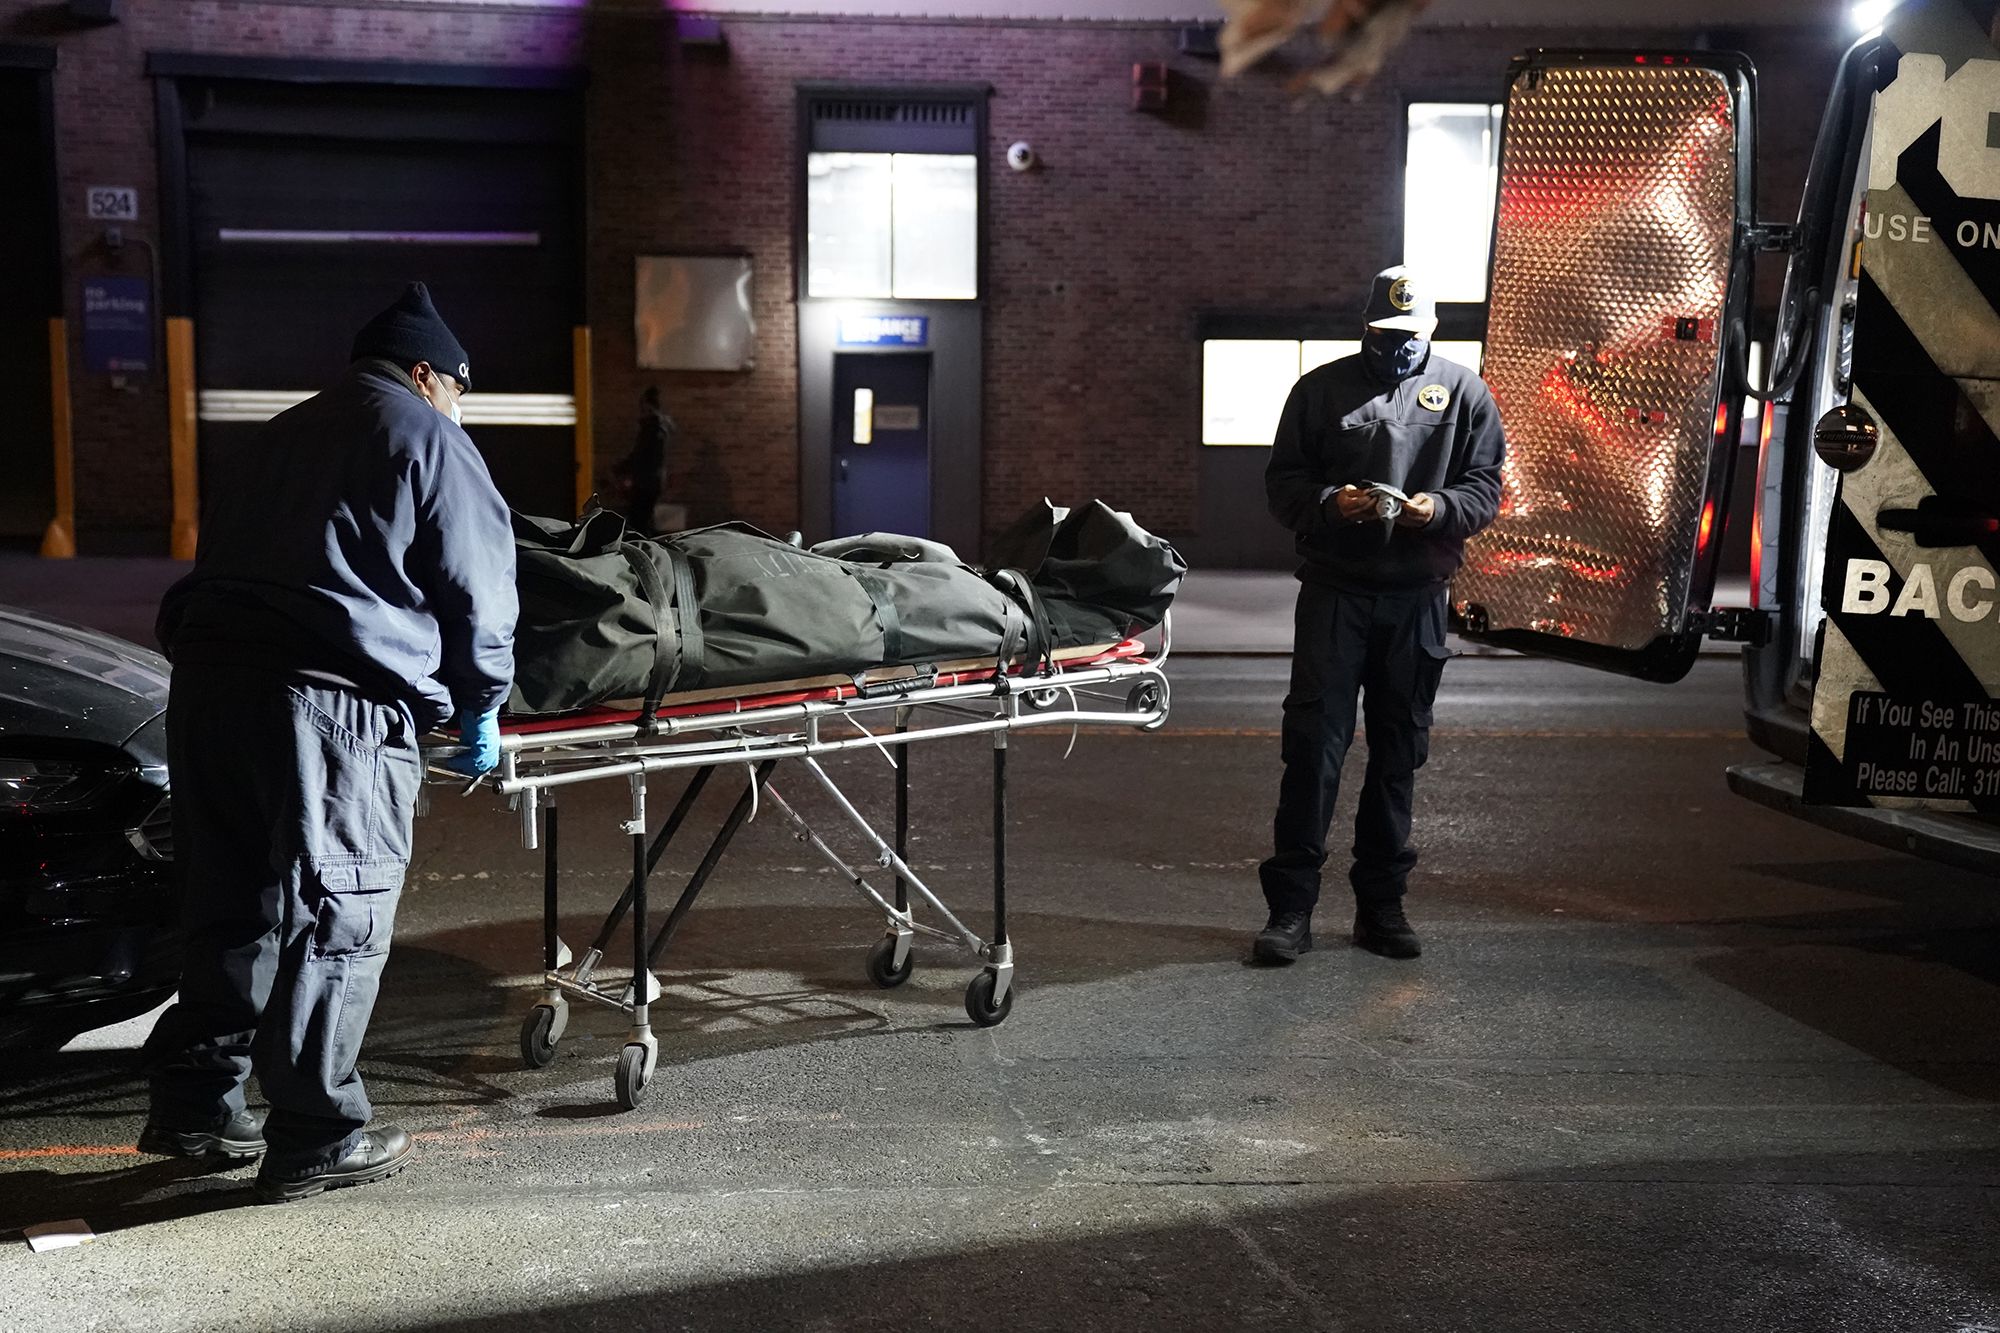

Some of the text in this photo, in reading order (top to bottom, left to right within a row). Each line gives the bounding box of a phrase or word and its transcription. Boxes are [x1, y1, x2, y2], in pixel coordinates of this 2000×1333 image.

[92, 192, 130, 215] 524
[1863, 211, 1932, 243] USE
[1841, 558, 2000, 624] BAC
[1856, 696, 2000, 732] If You See This
[1909, 732, 1927, 760] In
[1933, 734, 1960, 761] An
[1856, 762, 2000, 796] Please Call: 311
